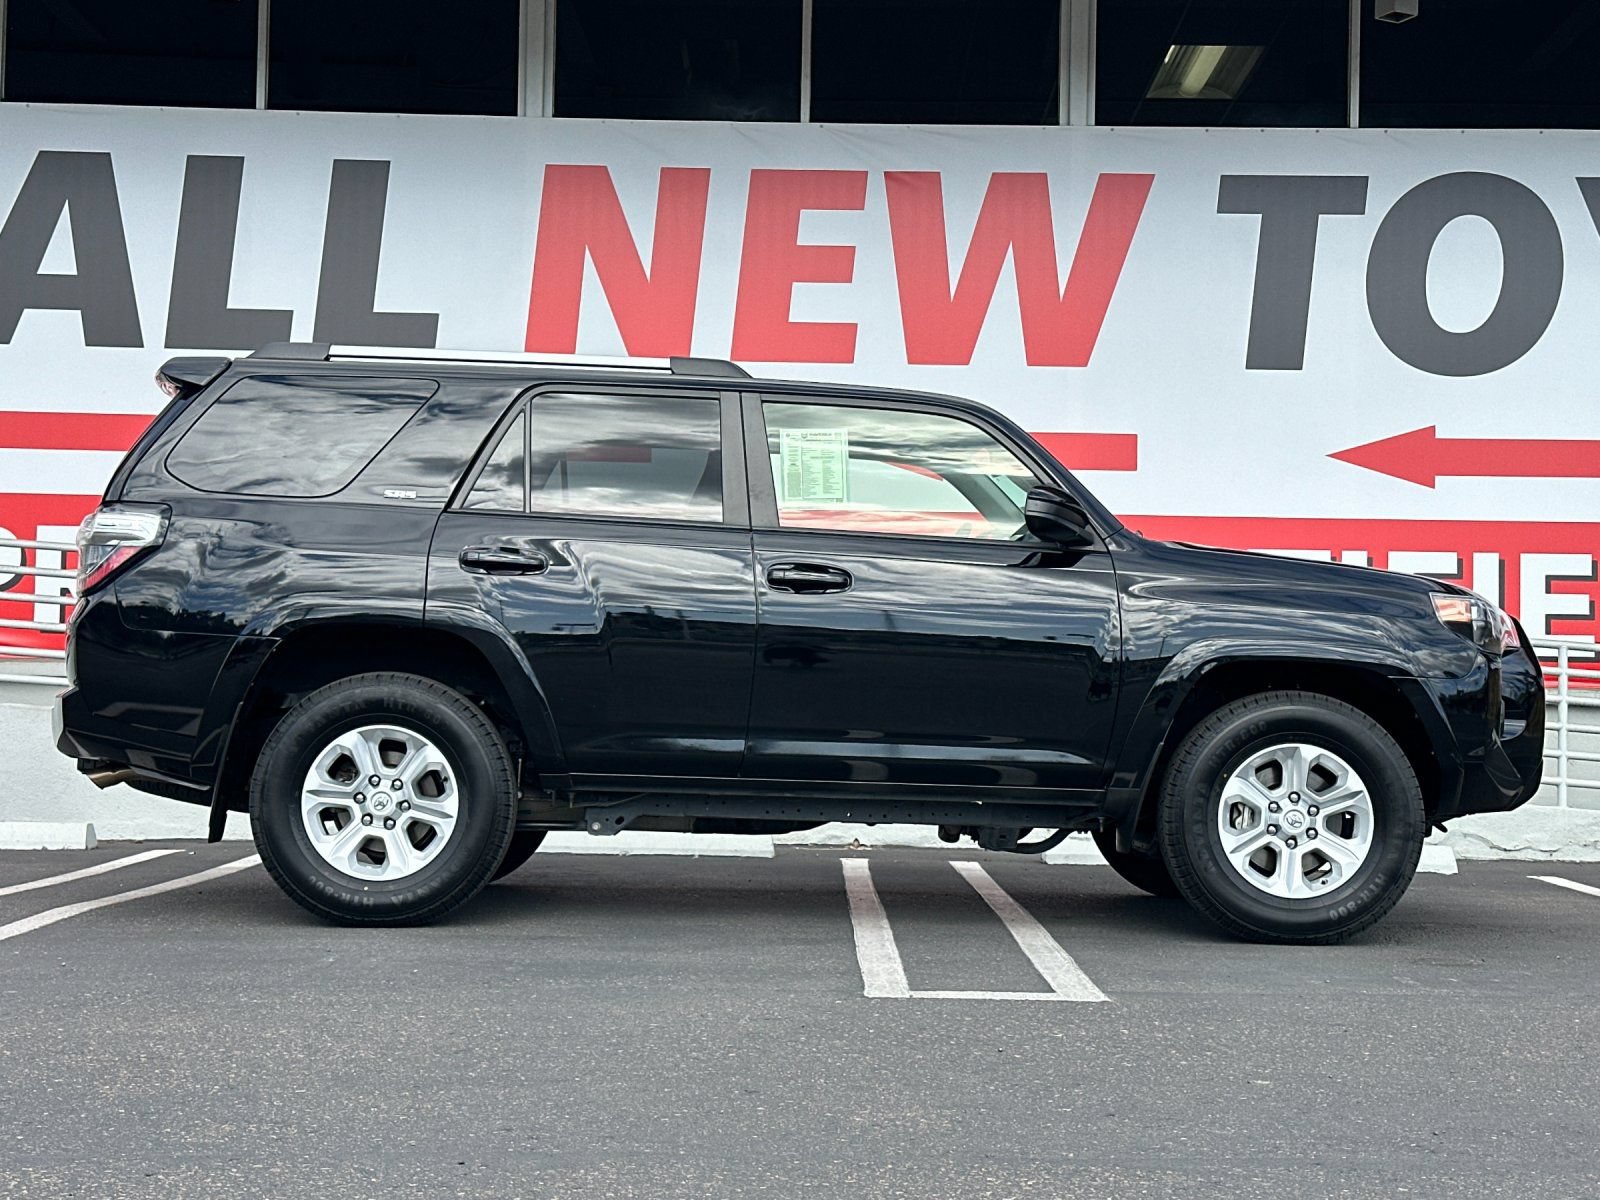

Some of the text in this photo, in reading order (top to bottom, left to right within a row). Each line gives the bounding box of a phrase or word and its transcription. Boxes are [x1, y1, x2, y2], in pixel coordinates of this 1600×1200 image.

[0, 150, 1600, 377] ALL NEW TO
